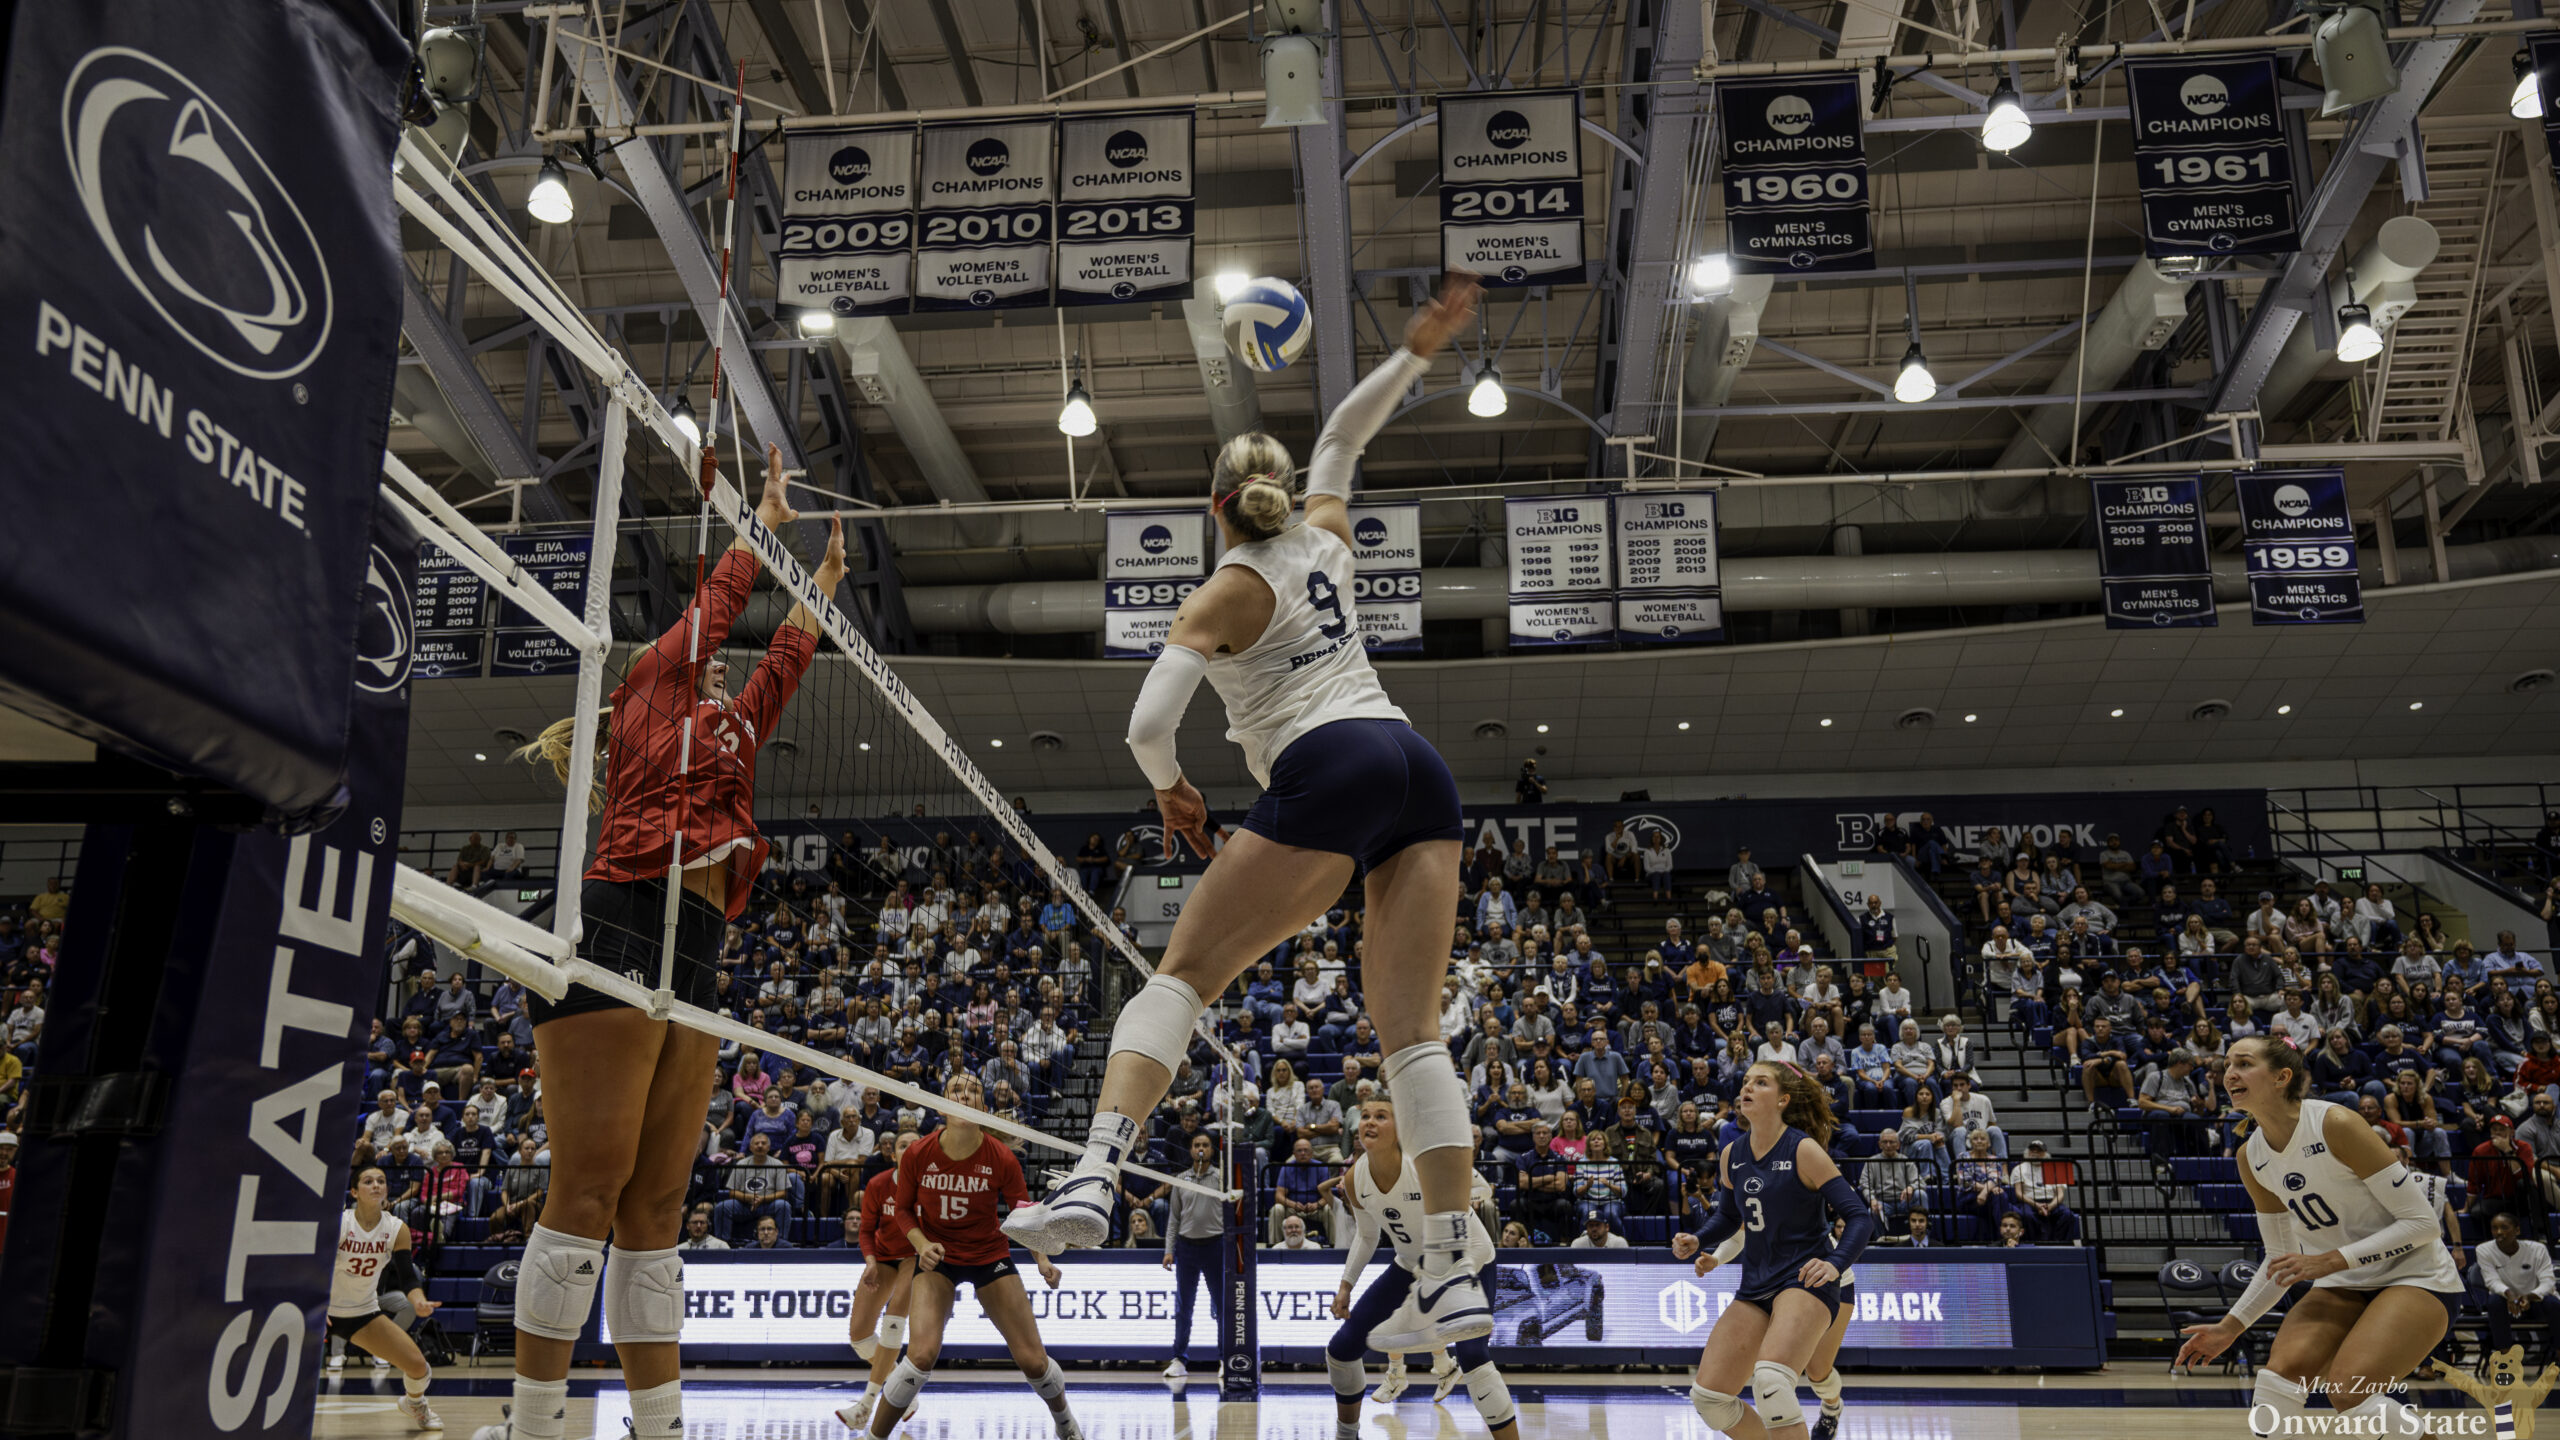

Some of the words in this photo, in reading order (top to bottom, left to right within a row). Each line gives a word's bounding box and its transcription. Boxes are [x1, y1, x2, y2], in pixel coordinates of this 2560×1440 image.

[2187, 93, 2227, 105] NCAA
[1772, 113, 1813, 125] NCAA
[2148, 113, 2271, 133] CHAMPIONS
[1491, 129, 1530, 140] NCAA
[1734, 135, 1855, 153] CHAMPIONS
[1110, 148, 1147, 159] NCAA
[1454, 151, 1568, 168] CHAMPIONS
[970, 154, 1006, 167] NCAA
[833, 164, 869, 176] NCAA
[2154, 151, 2270, 184] 1961
[932, 177, 1043, 193] CHAMPIONS
[1072, 170, 1182, 187] CHAMPIONS
[795, 185, 905, 202] CHAMPIONS
[1734, 172, 1859, 202] 1960
[1451, 187, 1570, 217] 2014
[2193, 204, 2244, 217] MEN'S
[1066, 205, 1182, 235] 2013
[2168, 214, 2273, 231] GYMNASTICS
[926, 213, 1042, 242] 2010
[1775, 221, 1825, 235] MEN'S
[783, 220, 909, 250] 2009
[1749, 234, 1853, 248] GYMNASTICS
[1477, 236, 1549, 249] WOMEN'S
[1090, 253, 1160, 266] WOMEN'S
[1465, 249, 1561, 262] VOLLEYBALL
[949, 260, 1019, 273] WOMEN'S
[1079, 266, 1170, 279] VOLLEYBALL
[811, 268, 880, 281] WOMEN'S
[937, 273, 1029, 286] VOLLEYBALL
[799, 281, 890, 294] VOLLEYBALL
[36, 300, 173, 439] PENN
[185, 409, 307, 530] STATE
[2105, 503, 2194, 516] CHAMPIONS
[2279, 500, 2310, 509] NCAA
[1624, 519, 1708, 531] CHAMPIONS
[2110, 525, 2145, 534] 2003
[2251, 517, 2344, 530] CHAMPIONS
[1358, 531, 1387, 540] NCAA
[1516, 524, 1602, 537] CHAMPIONS
[536, 542, 563, 552] EIVA
[1143, 538, 1171, 548] NCAA
[2113, 537, 2145, 546] 2015
[2161, 535, 2193, 545] 2019
[1352, 549, 1415, 560] AMPIONS
[2253, 546, 2349, 569] 1959
[1115, 556, 1199, 567] CHAMPIONS
[1630, 575, 1660, 584] 2017
[1354, 576, 1420, 598] 008
[2287, 584, 2325, 595] MEN'S
[2141, 589, 2178, 599] MEN'S
[2268, 594, 2348, 605] GYMNASTICS
[737, 499, 786, 571] PENN
[789, 562, 834, 626] STATE
[839, 613, 914, 716] VOLLEYBALL
[1307, 570, 1346, 639] 9
[1643, 603, 1697, 612] WOMEN'S
[2122, 599, 2199, 610] GYMNASTICS
[1357, 613, 1400, 622] OMEN'S
[1534, 607, 1590, 617] WOMEN'S
[1635, 612, 1706, 623] VOLLEYBALL
[1130, 620, 1172, 629] WOMEN
[1359, 623, 1408, 632] LEYBALL
[1526, 616, 1598, 627] VOLLEYBALL
[1122, 630, 1169, 639] VOLLEYB
[421, 643, 453, 652] MEN'S
[525, 639, 556, 648] MEN'S
[413, 651, 468, 662] OLLEYBALL
[508, 647, 572, 658] VOLLEYBALL
[944, 735, 968, 775] PENN
[1463, 817, 1579, 861] ATE
[1160, 877, 1180, 886] EXIT
[1844, 891, 1863, 905] S4
[1162, 902, 1180, 917] S3
[208, 833, 376, 1432] STATE
[921, 1174, 990, 1193] INDIANA
[940, 1195, 969, 1220] 15
[1745, 1197, 1766, 1231] 3
[2288, 1192, 2339, 1231] 10
[1389, 1223, 1412, 1244] 5
[2358, 1251, 2382, 1265] WE
[2385, 1243, 2414, 1259] ARE
[346, 1257, 378, 1277] 32
[1235, 1281, 1245, 1310] PENN
[684, 1290, 734, 1318] HE
[745, 1290, 857, 1318] TOUG
[1119, 1290, 1177, 1320] BE
[1235, 1313, 1245, 1346] STATE
